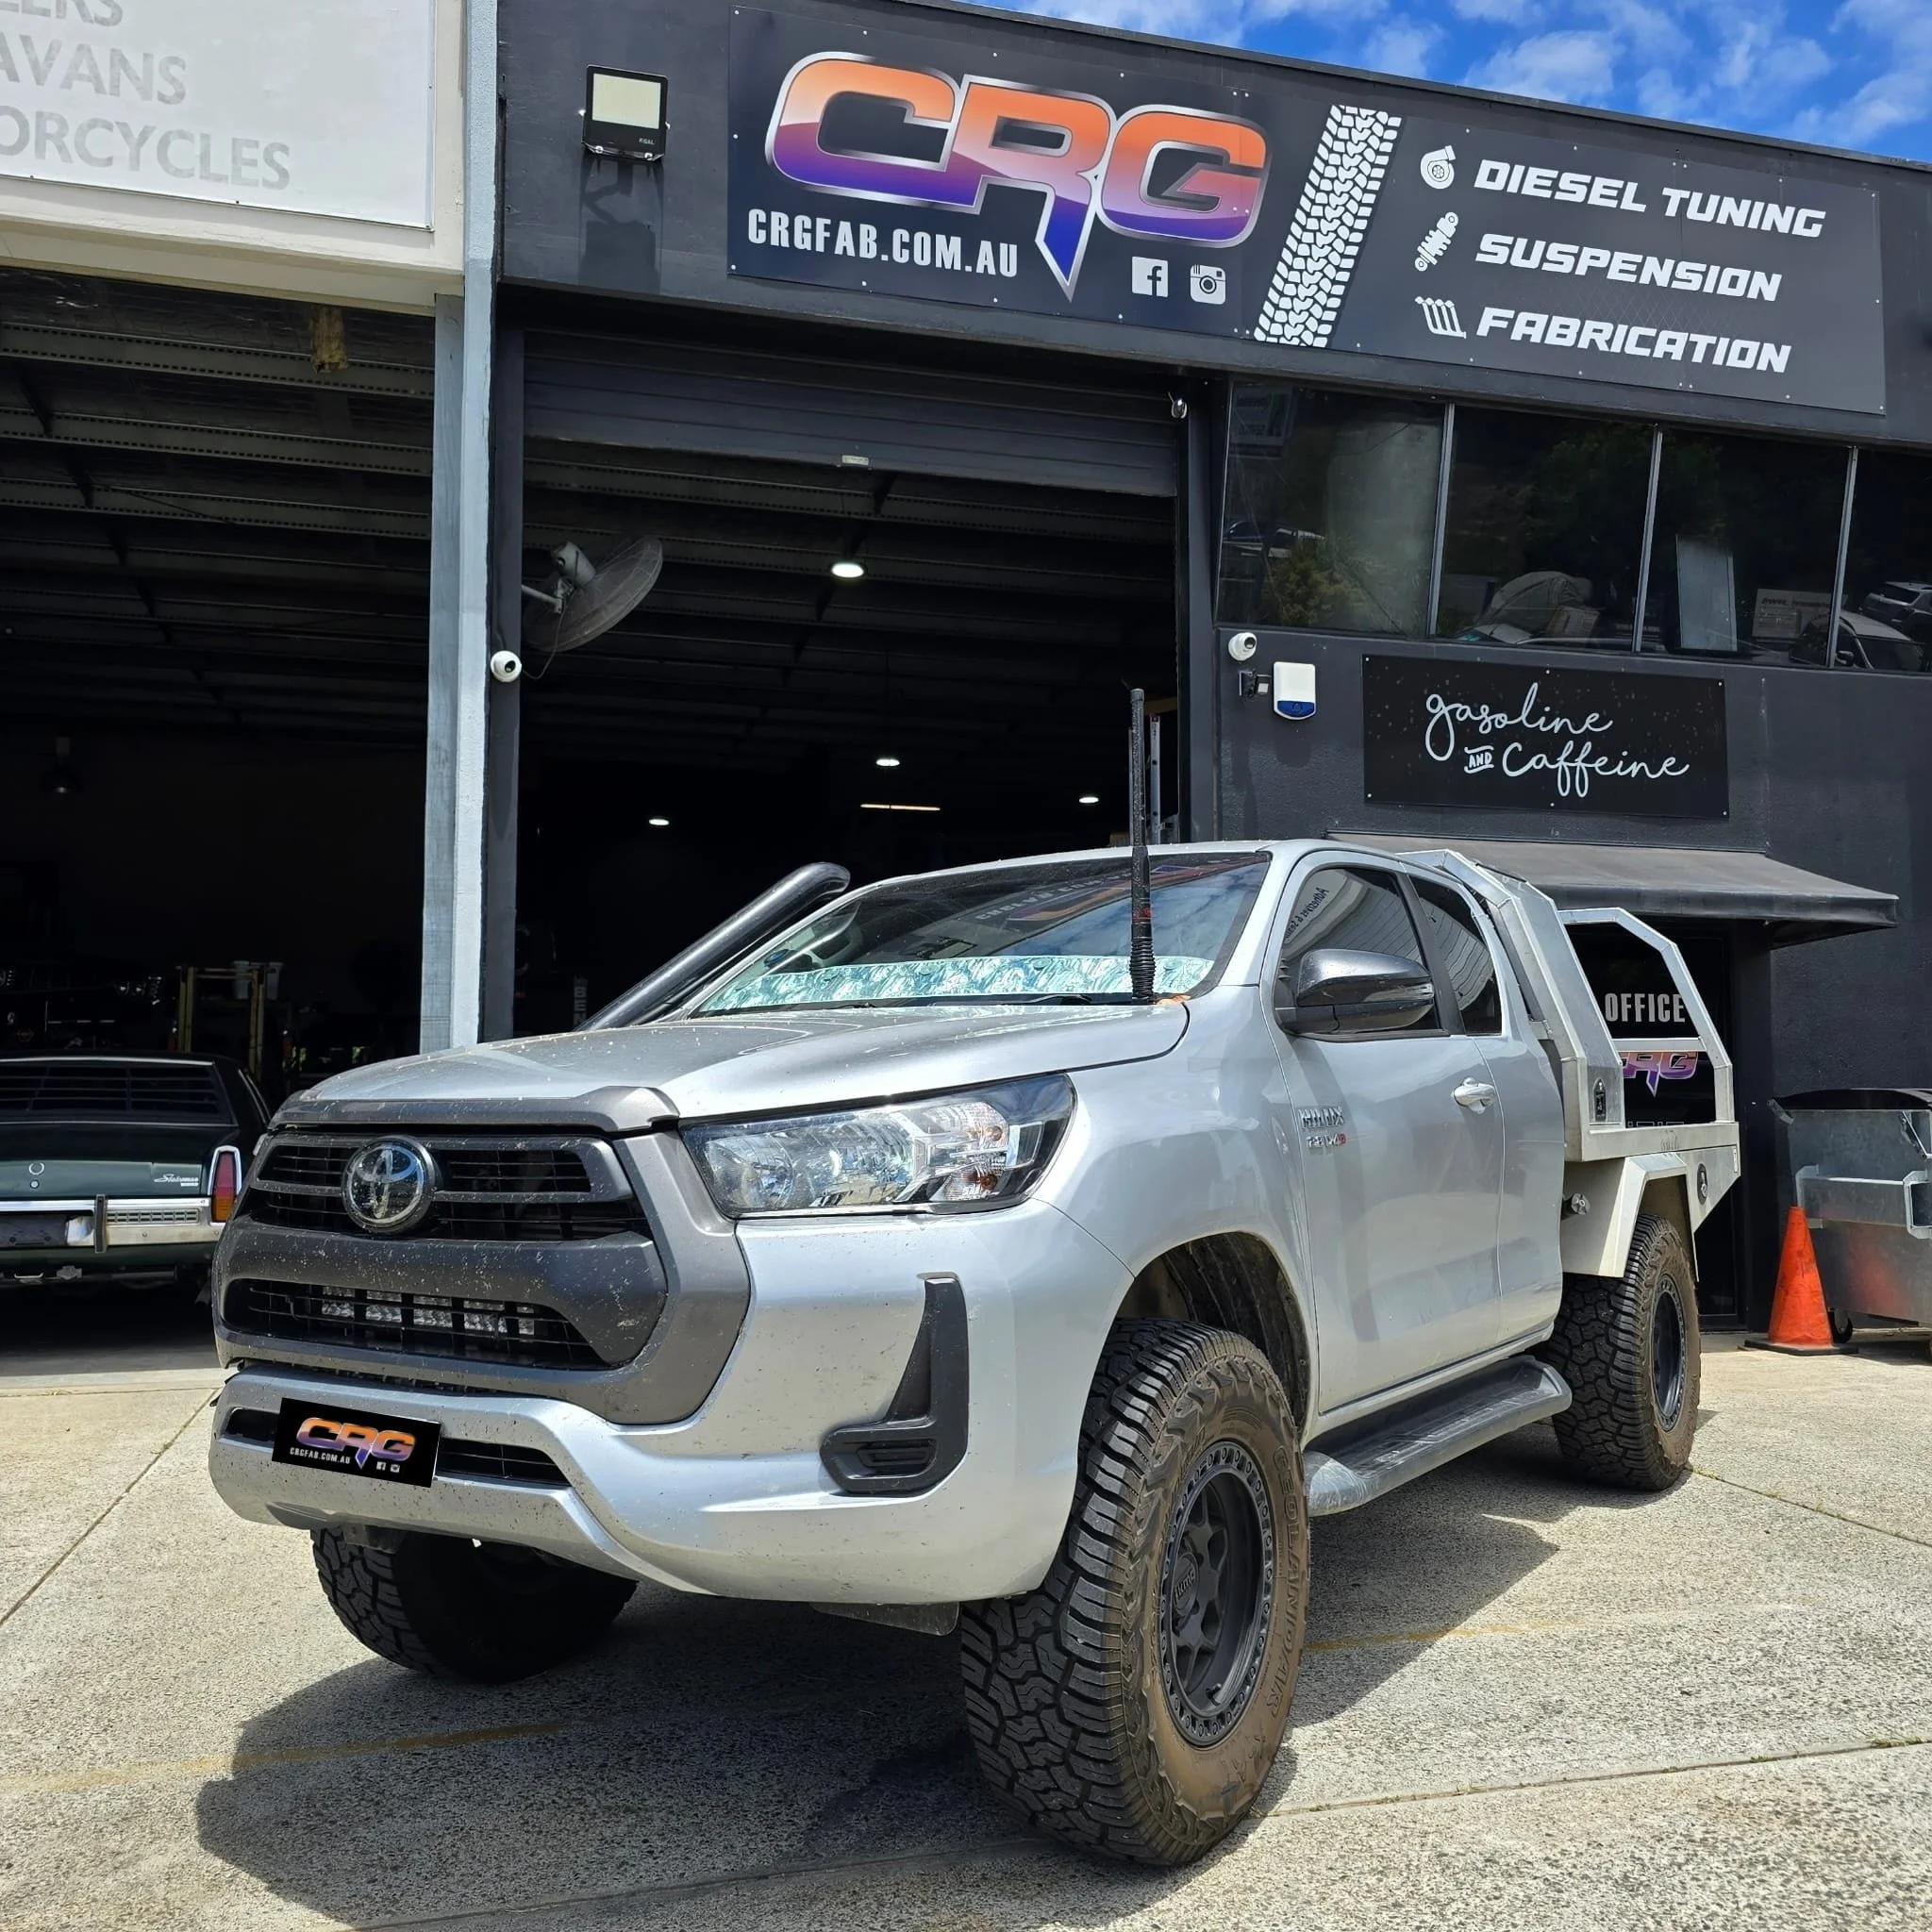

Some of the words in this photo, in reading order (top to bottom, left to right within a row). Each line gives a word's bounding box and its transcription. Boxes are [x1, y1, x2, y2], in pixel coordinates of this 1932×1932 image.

[765, 51, 1272, 302] CRG
[1474, 159, 1646, 213] DIESEL
[1662, 188, 1827, 238] TUNING
[748, 208, 1018, 278] CRGFAB.COM.AU
[1475, 233, 1783, 302] SUSPENSION
[1476, 307, 1792, 374] FABRICATION
[1425, 682, 1613, 761] gasoline
[1468, 752, 1493, 770] AND
[1605, 992, 1686, 1023] OFFICE
[1619, 1051, 1698, 1097] RG
